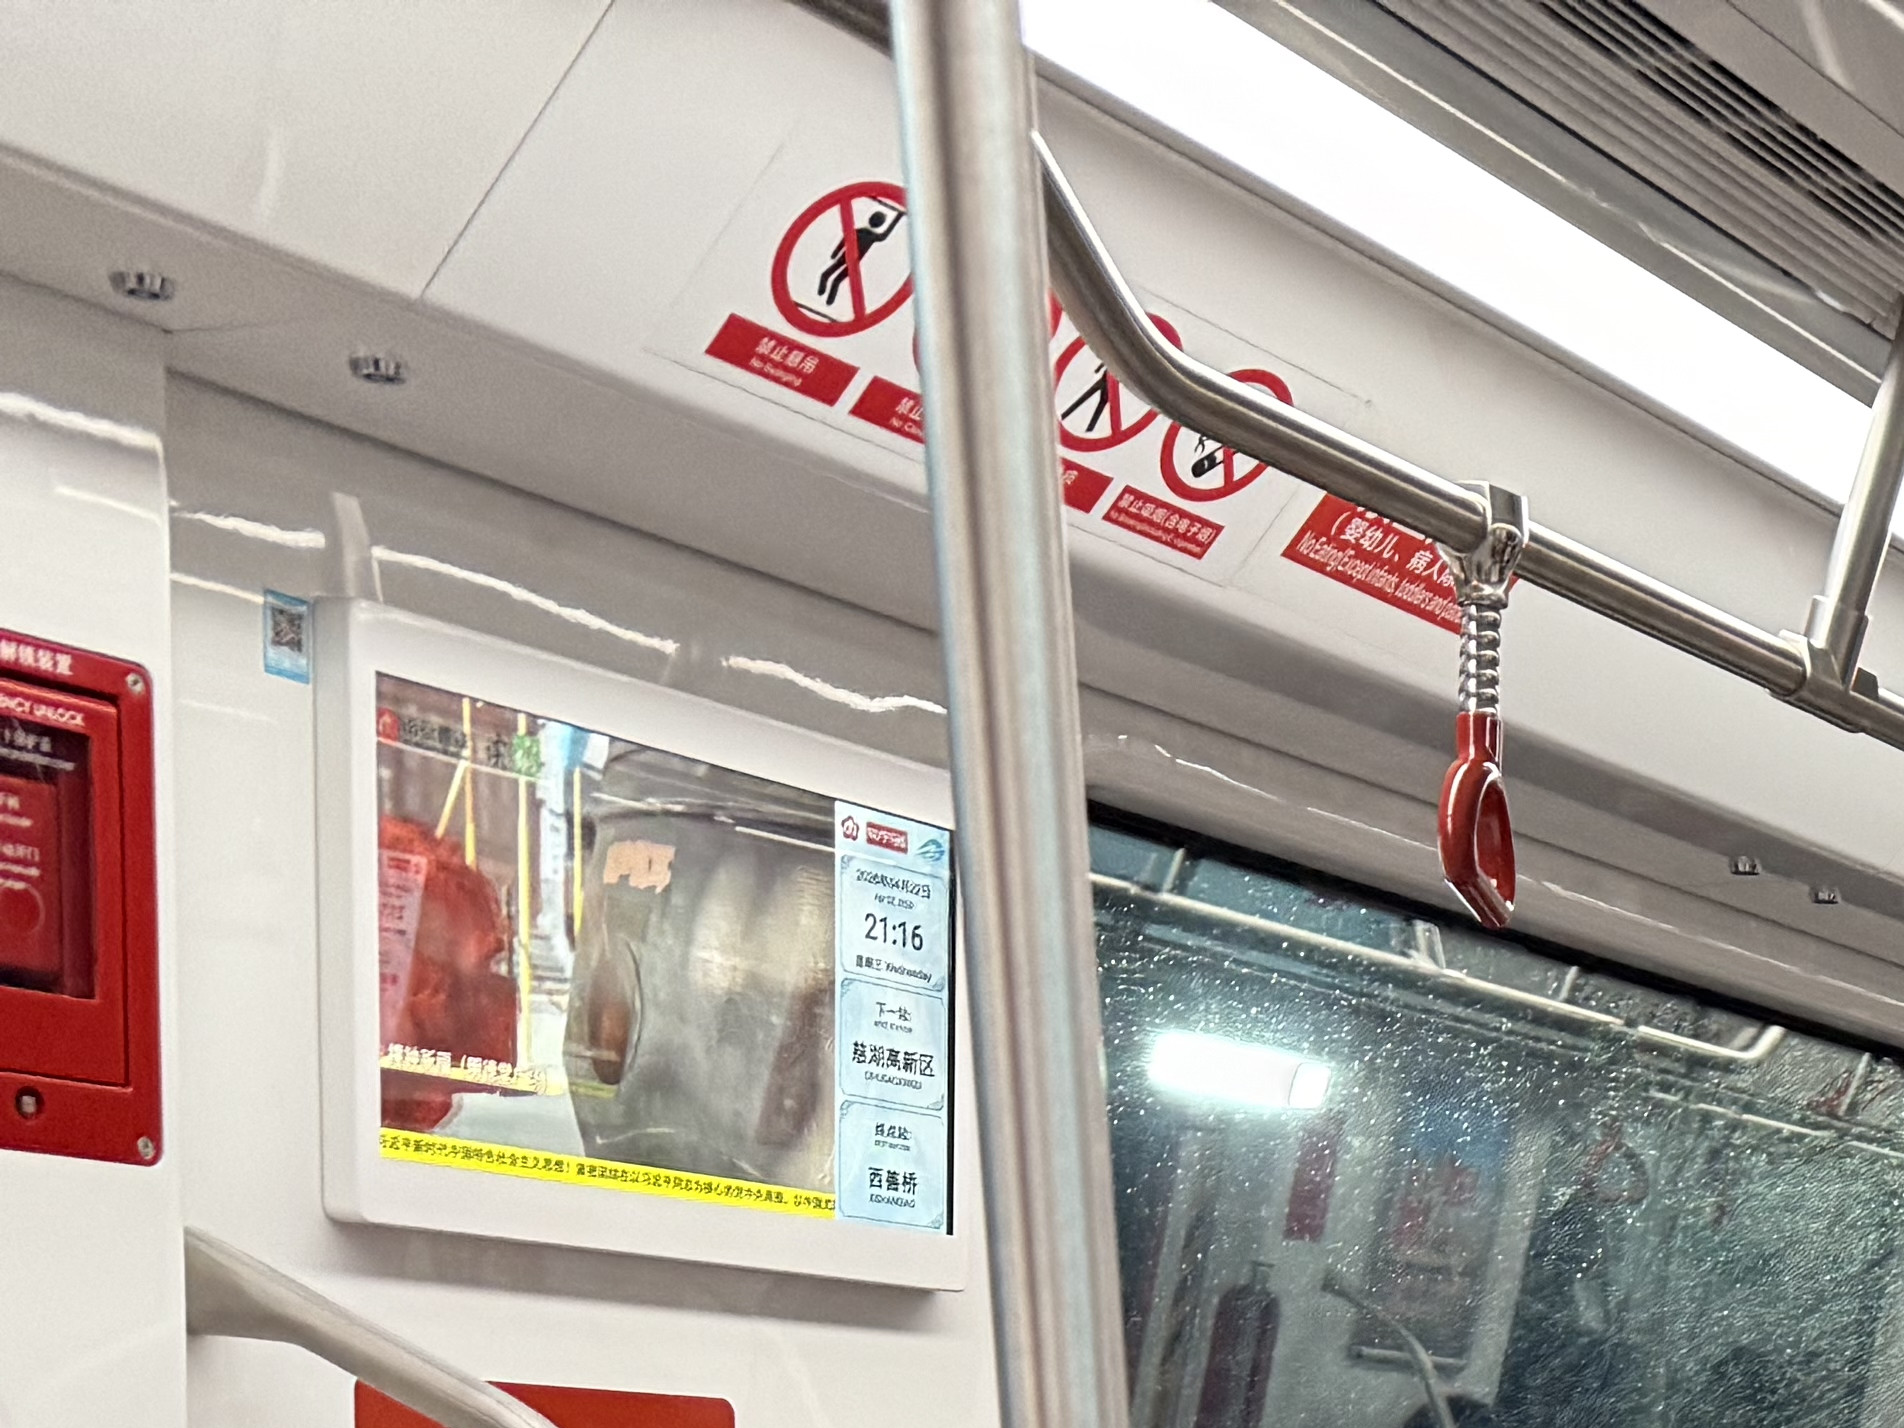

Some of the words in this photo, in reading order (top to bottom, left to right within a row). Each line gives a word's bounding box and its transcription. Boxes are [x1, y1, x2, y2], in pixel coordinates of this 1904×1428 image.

[895, 397, 924, 421] 禁止
[864, 912, 924, 951] 21:16
[852, 1040, 935, 1078] 慈湖高新区
[868, 1166, 918, 1196] 西善桥
